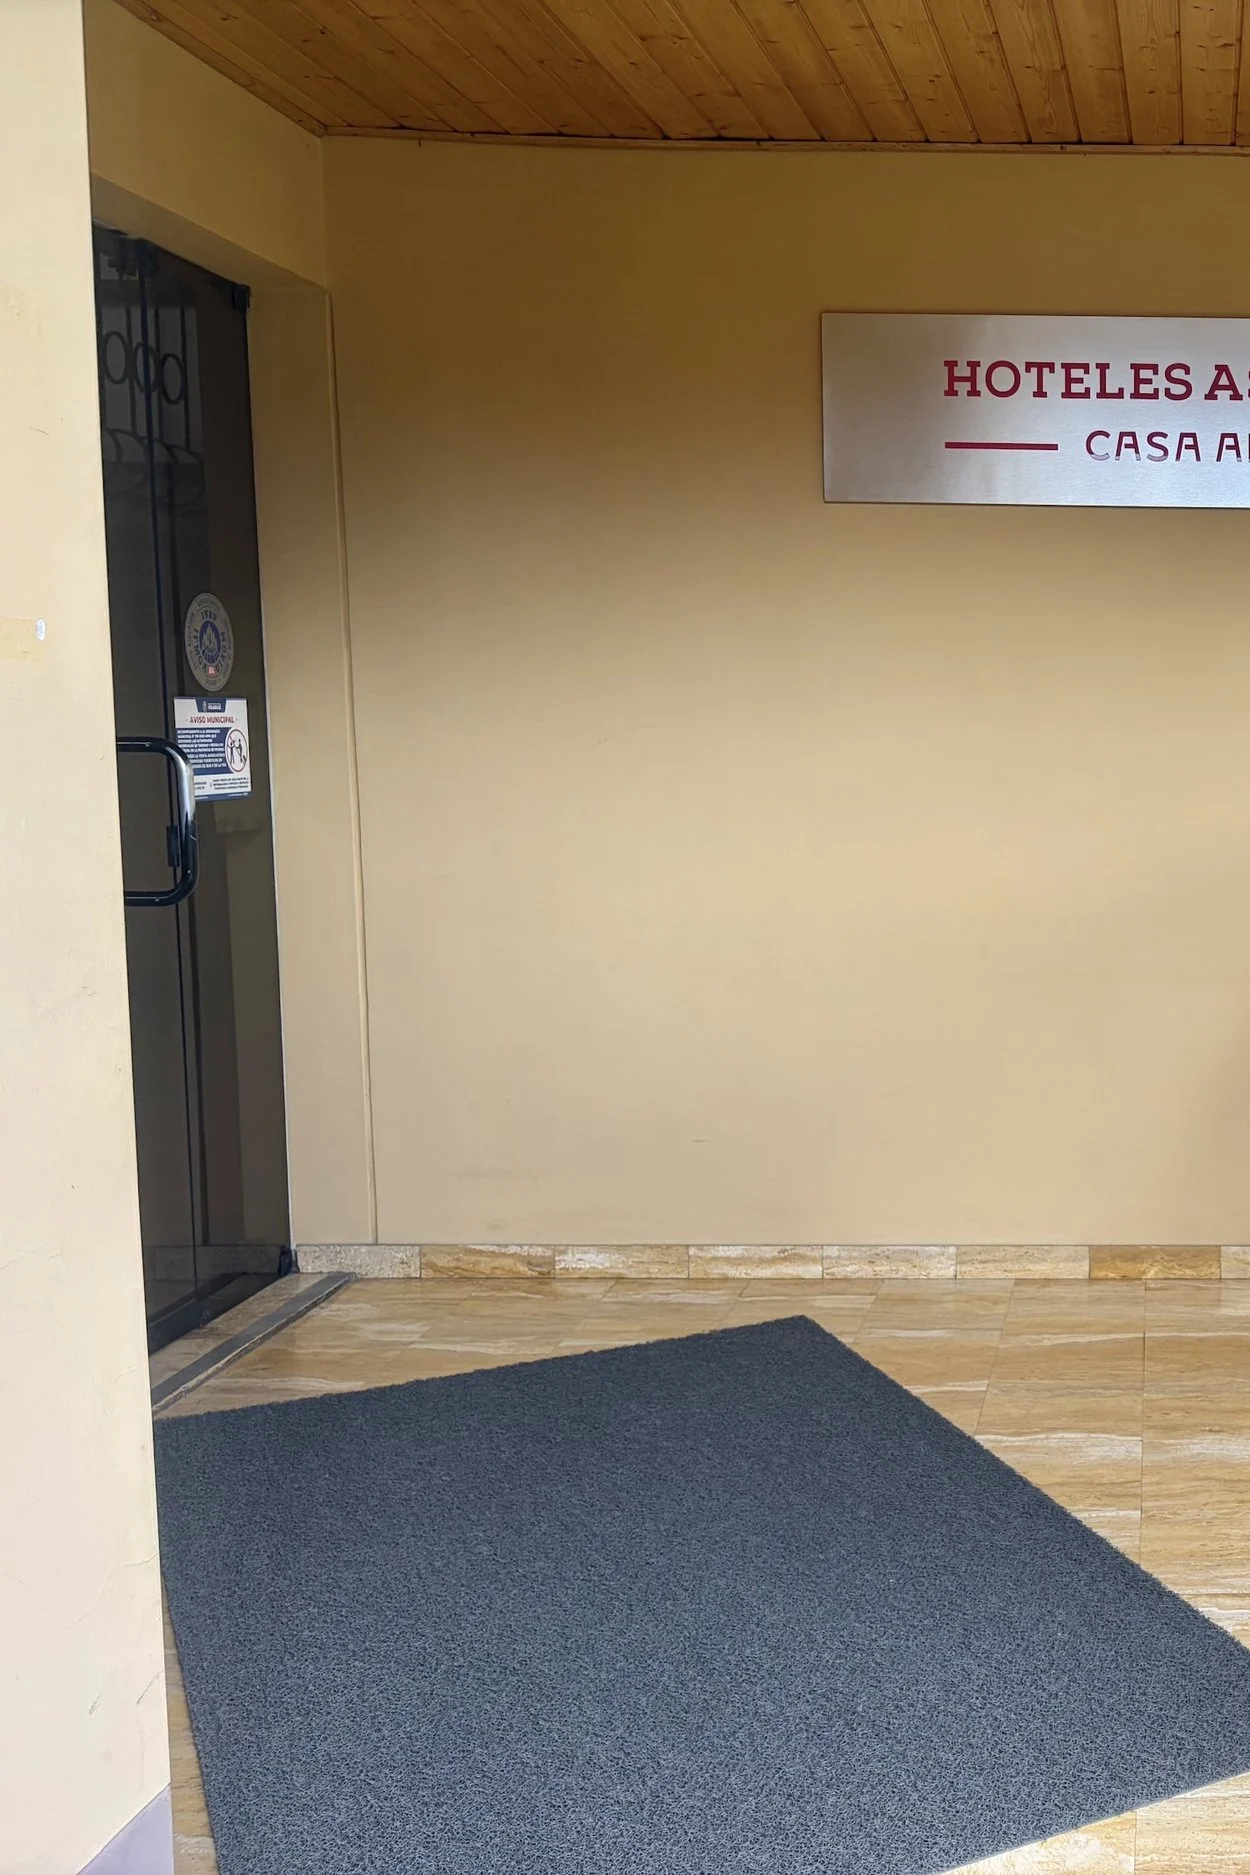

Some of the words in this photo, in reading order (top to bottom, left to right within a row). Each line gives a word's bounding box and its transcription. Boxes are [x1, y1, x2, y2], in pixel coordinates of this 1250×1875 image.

[943, 360, 1194, 400] HOTELES
[1085, 430, 1201, 462] CASA
[189, 716, 206, 724] AVISO
[206, 716, 235, 724] MUNICIPAL
